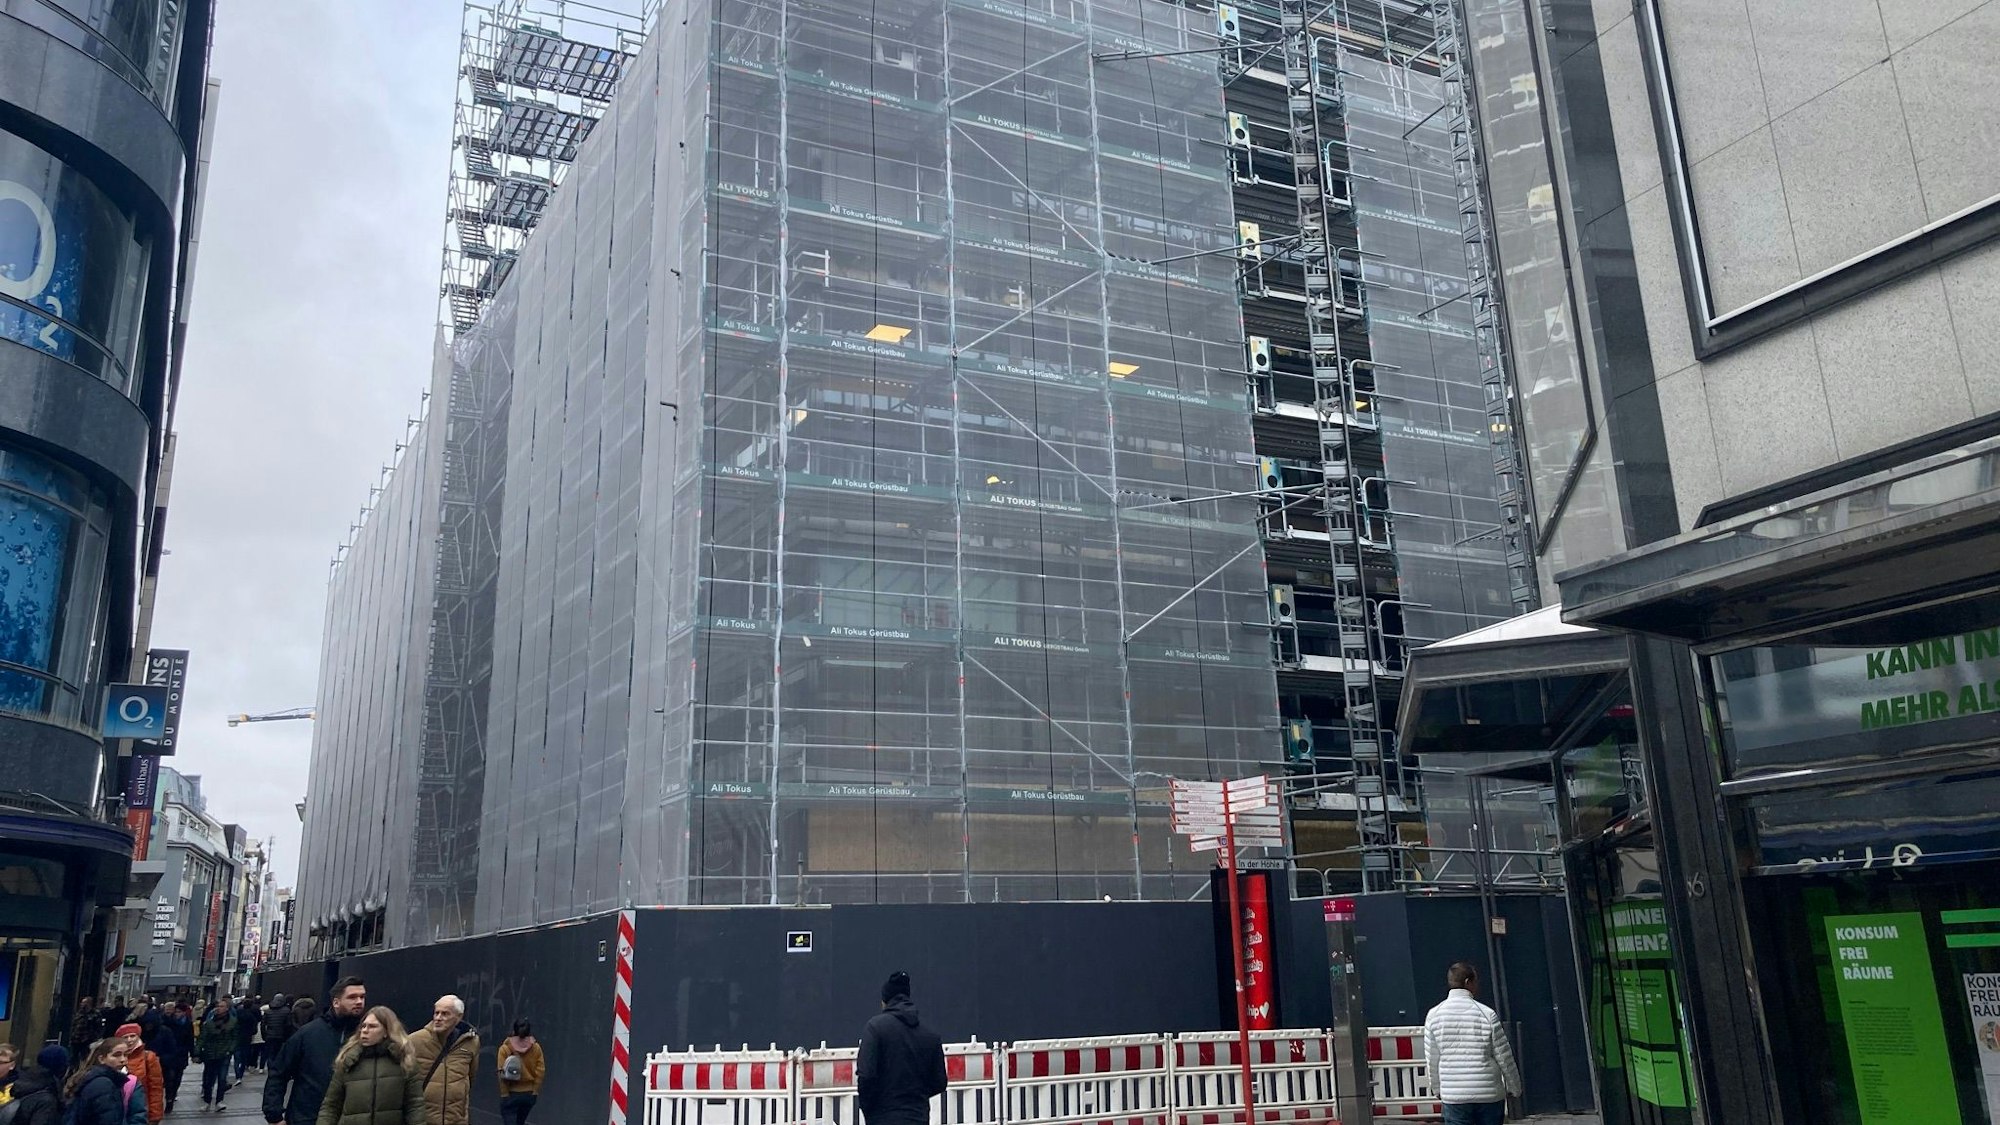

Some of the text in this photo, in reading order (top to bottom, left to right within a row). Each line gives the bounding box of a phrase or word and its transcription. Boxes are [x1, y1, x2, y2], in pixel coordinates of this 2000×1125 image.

[717, 181, 770, 198] ALI TOKUS
[737, 321, 760, 333] Tokus
[736, 467, 760, 478] Tokus
[845, 479, 867, 490] Tokus
[990, 494, 1005, 504] ALI
[1006, 496, 1037, 507] TOKUS
[729, 619, 756, 630] Tokus
[843, 627, 867, 638] Tokus
[868, 629, 909, 639] Gerüstbau
[994, 636, 1010, 646] ALI
[1011, 638, 1042, 649] TOKUS
[1866, 636, 1957, 681] KANN
[163, 658, 184, 746] DU MONDE
[1860, 688, 1950, 730] MEHR
[725, 783, 752, 794] Tokus
[1023, 790, 1045, 801] Tokus
[1835, 925, 1899, 940] KONSUM
[1838, 946, 1869, 960] FREI
[1842, 962, 1894, 980] RÄUME
[1969, 989, 2000, 1002] FREI
